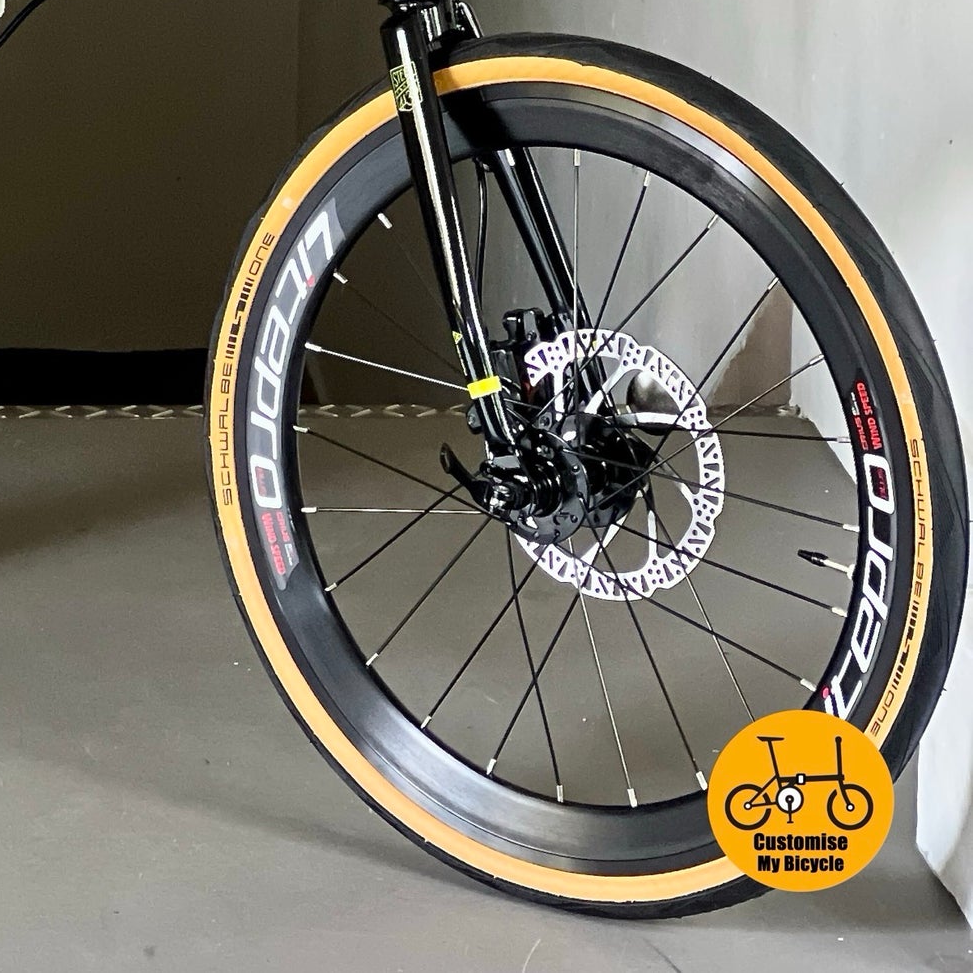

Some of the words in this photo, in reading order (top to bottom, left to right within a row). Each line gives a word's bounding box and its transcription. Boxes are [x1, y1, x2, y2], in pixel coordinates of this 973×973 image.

[249, 231, 275, 277] ONE
[249, 211, 334, 510] Litepro
[856, 382, 873, 416] SPEED
[218, 361, 234, 506] SCHWALBE
[866, 417, 883, 450] WIND
[261, 511, 277, 545] WIND
[270, 543, 287, 576] SPEED
[910, 438, 926, 599] SCHWALBE
[870, 689, 896, 738] ONE
